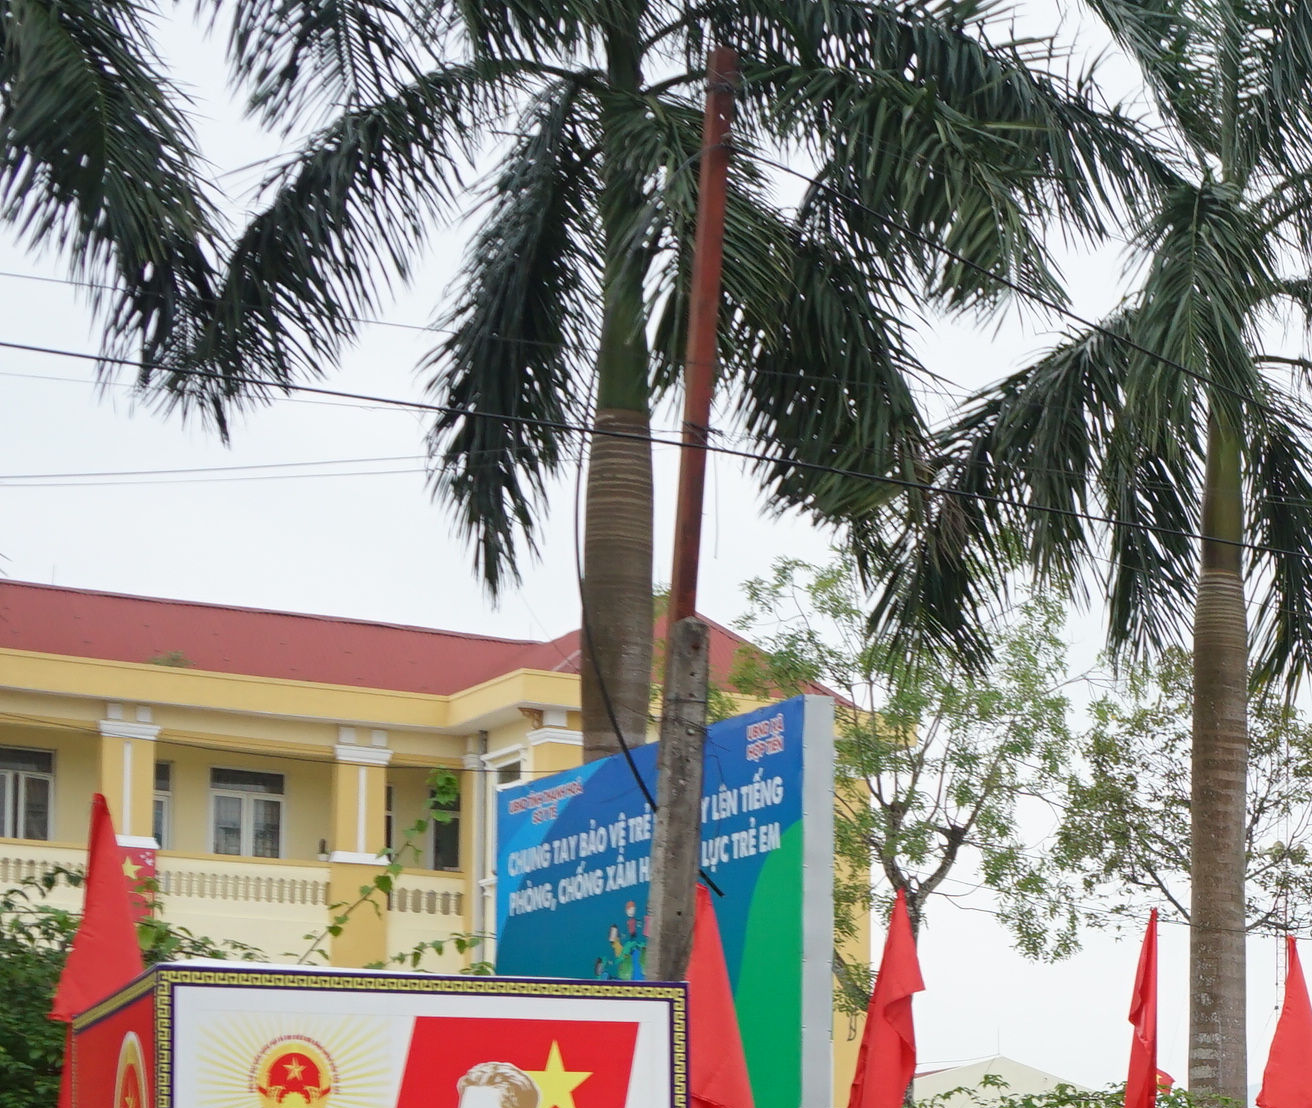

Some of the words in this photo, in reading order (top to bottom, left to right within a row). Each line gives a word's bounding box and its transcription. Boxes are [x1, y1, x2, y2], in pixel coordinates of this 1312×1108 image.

[712, 784, 738, 820] LÊN
[740, 767, 783, 812] TIẾNG
[508, 843, 551, 876] CHUNG
[552, 835, 578, 864] TAY
[579, 819, 607, 857] BẢO
[609, 812, 626, 853] VỆ
[628, 802, 651, 843] TRẺ
[702, 836, 729, 872] LỰC
[731, 817, 756, 859] TRẺ
[759, 822, 781, 852] EM
[509, 880, 556, 916] PHÒNG,
[558, 861, 603, 904] CHỐNG
[606, 855, 637, 891] XÂM
